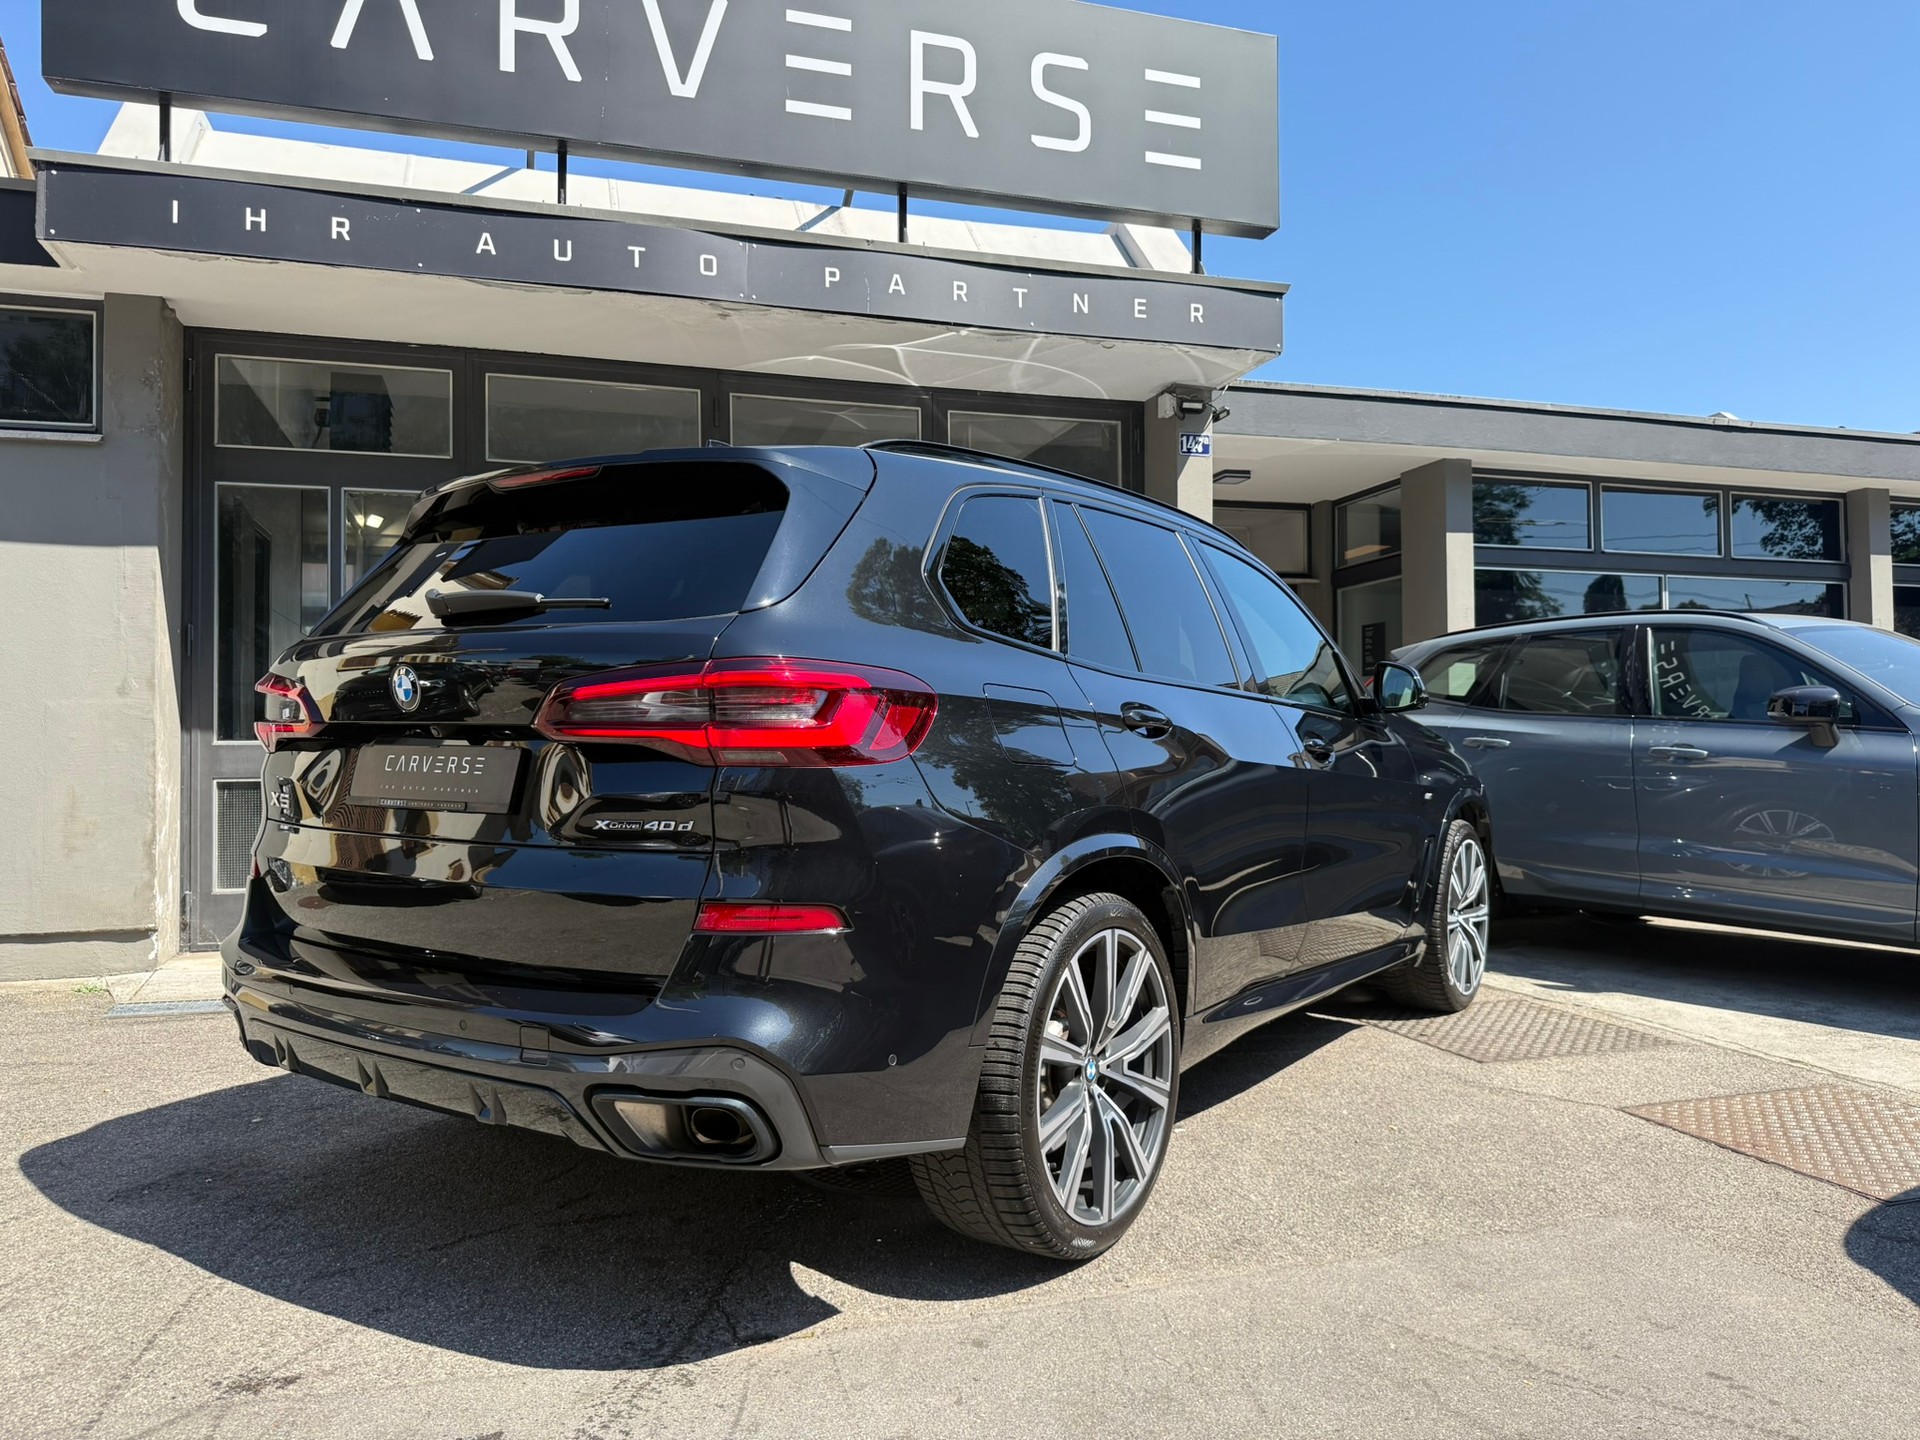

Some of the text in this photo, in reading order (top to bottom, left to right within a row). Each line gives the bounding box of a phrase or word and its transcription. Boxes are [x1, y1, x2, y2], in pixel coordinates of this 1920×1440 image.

[178, 0, 1201, 170] RVERSE
[172, 200, 1205, 324] IHR AUTO PARTNER
[385, 754, 486, 775] CARVERSE
